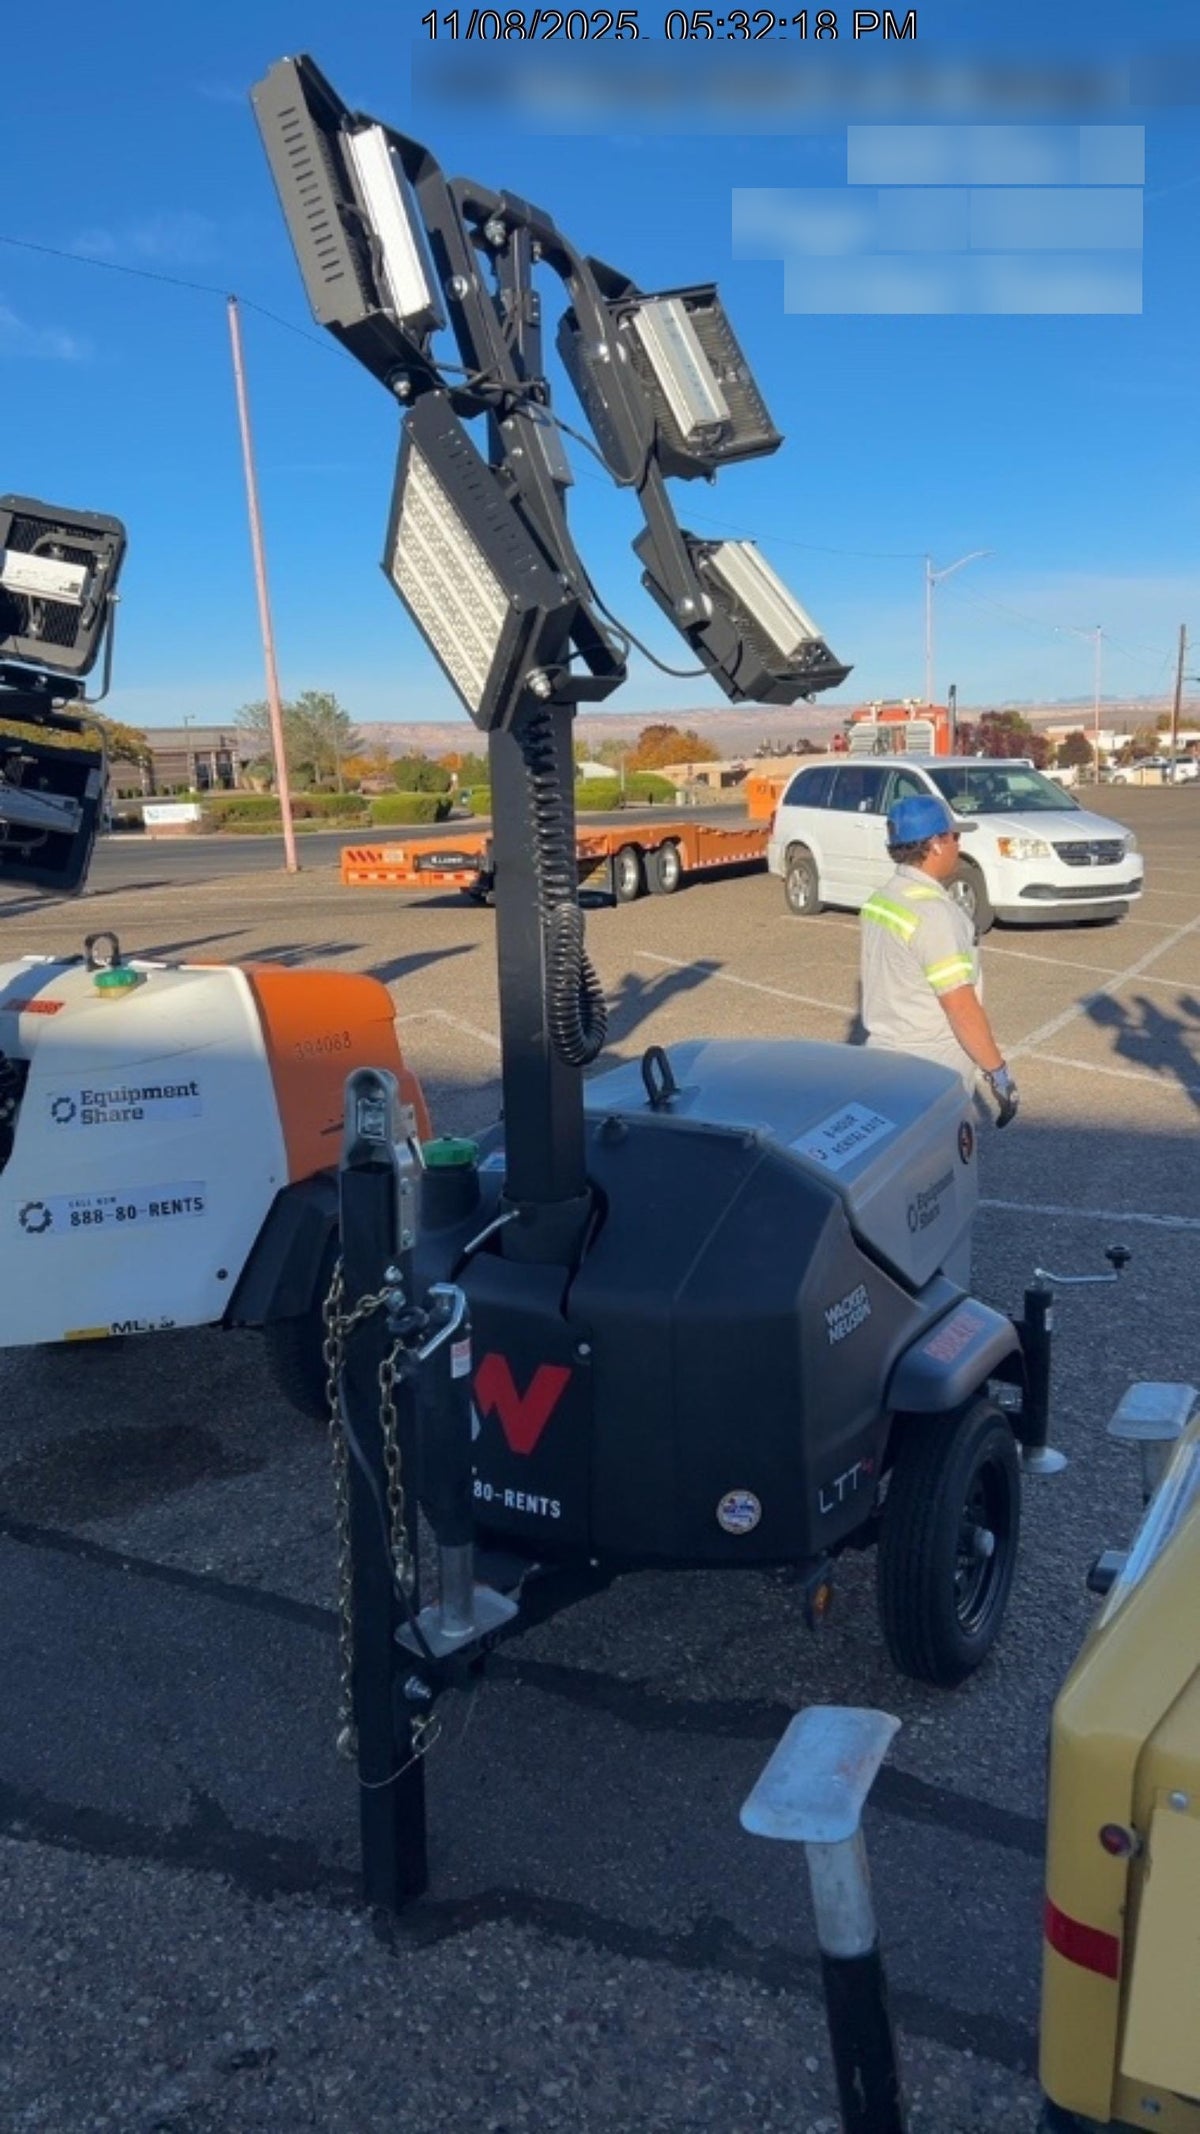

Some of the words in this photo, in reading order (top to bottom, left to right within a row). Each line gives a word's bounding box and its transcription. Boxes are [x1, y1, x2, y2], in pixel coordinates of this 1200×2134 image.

[80, 1080, 200, 1106] Equipment
[80, 1107, 145, 1125] Share
[69, 1197, 205, 1227] 888-80-RENTS
[824, 1284, 868, 1326] WACKER
[829, 1298, 872, 1344] NEUSON
[473, 1479, 562, 1519] 80-RENTS
